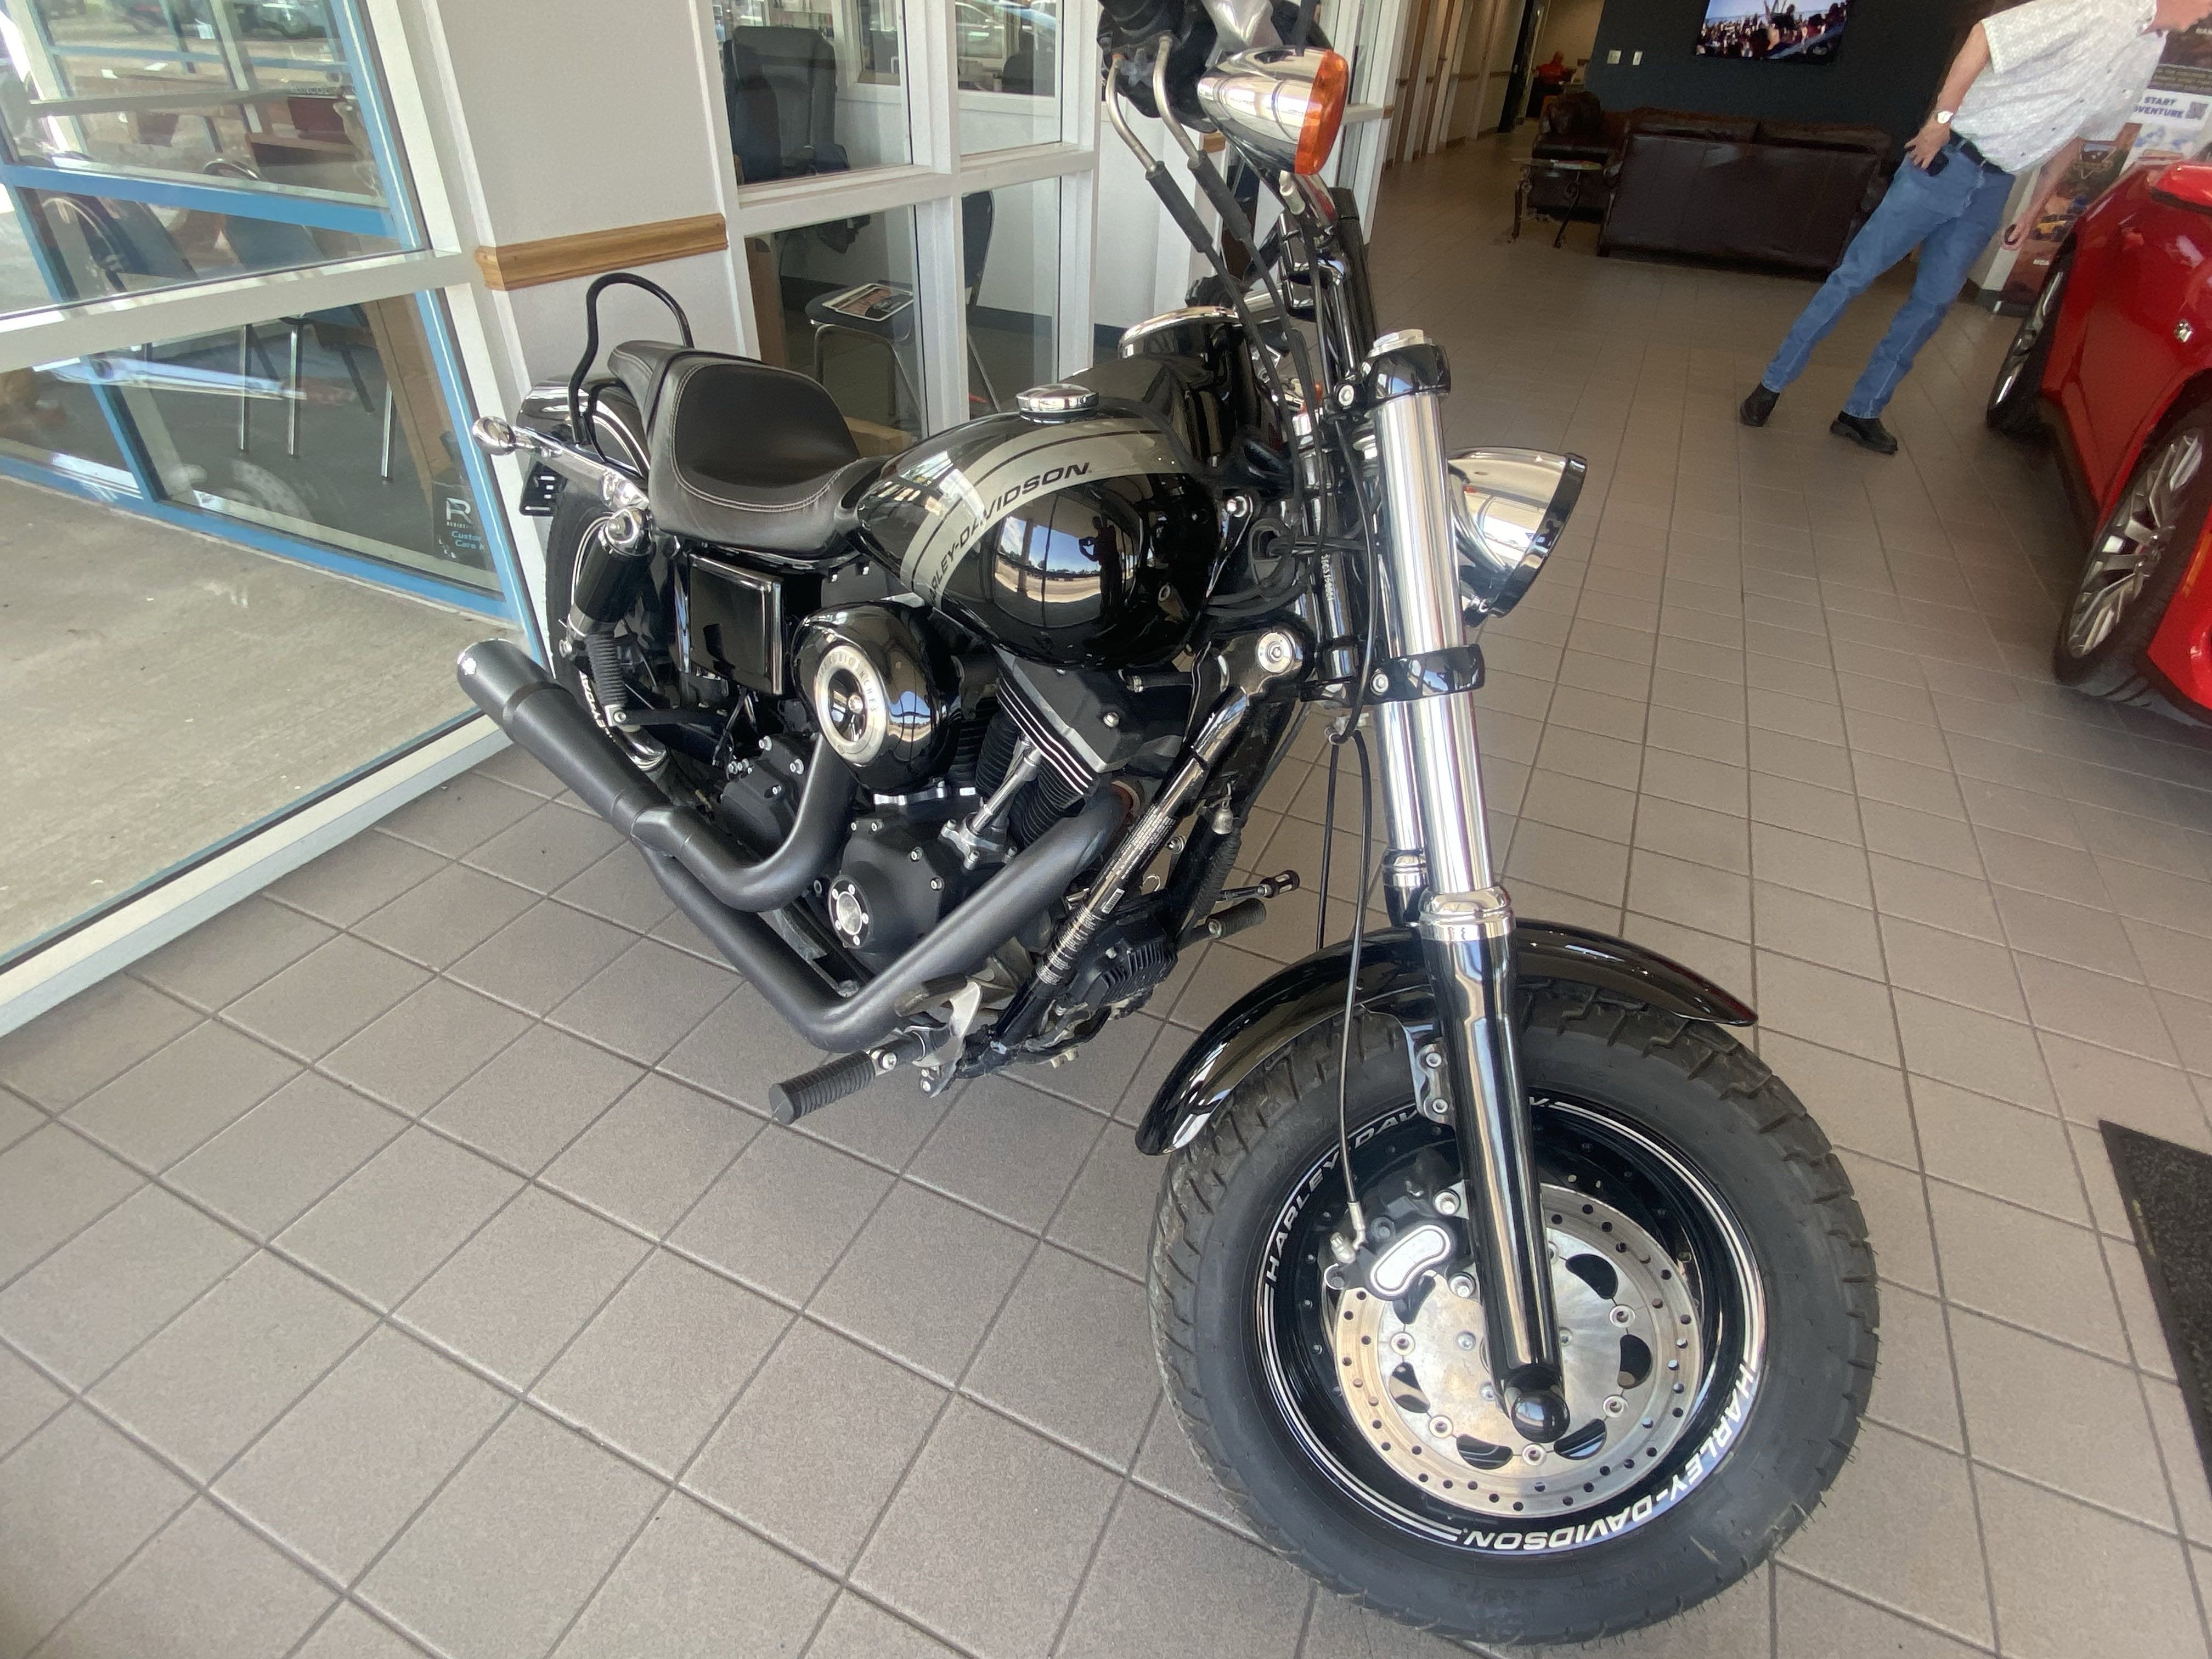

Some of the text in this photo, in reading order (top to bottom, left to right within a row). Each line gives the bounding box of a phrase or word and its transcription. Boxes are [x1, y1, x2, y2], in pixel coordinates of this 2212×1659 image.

[2134, 105, 2185, 119] VENTURE
[2143, 96, 2177, 106] START
[829, 653, 855, 665] CUBIC
[856, 663, 877, 712] INCHES
[1464, 1363, 1754, 1550] HARLEY-DAVIDSON
